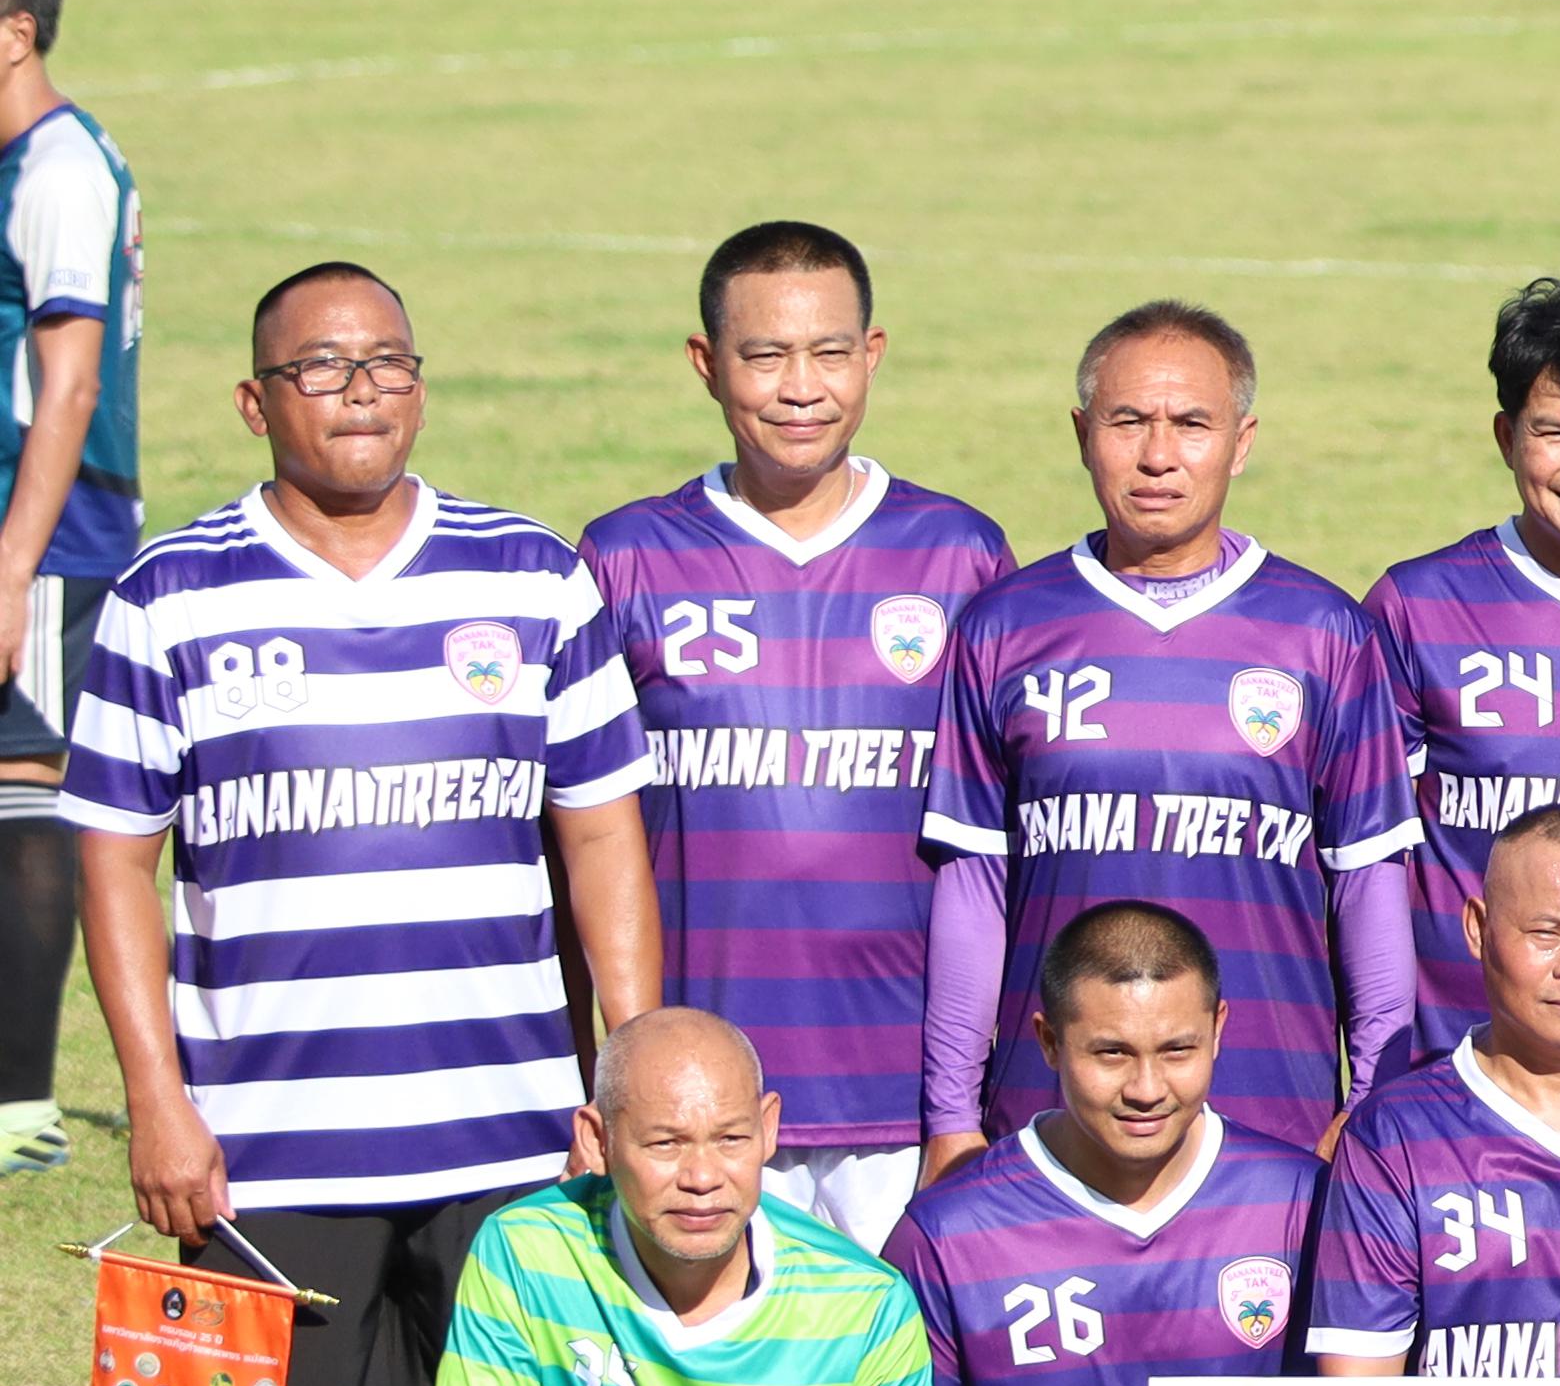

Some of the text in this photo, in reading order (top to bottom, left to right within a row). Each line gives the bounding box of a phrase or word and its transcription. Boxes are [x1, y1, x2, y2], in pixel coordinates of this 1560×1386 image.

[662, 597, 760, 676] 25
[208, 635, 309, 720] 88
[1024, 663, 1112, 743] 42
[1460, 649, 1555, 728] 24
[368, 760, 486, 832] TREE
[646, 727, 788, 793] BANANA
[801, 727, 905, 794] TREE
[1152, 793, 1253, 860] TREE
[1430, 1189, 1528, 1273] 34
[1001, 1274, 1106, 1366] 26
[1420, 1322, 1558, 1378] ANANA
